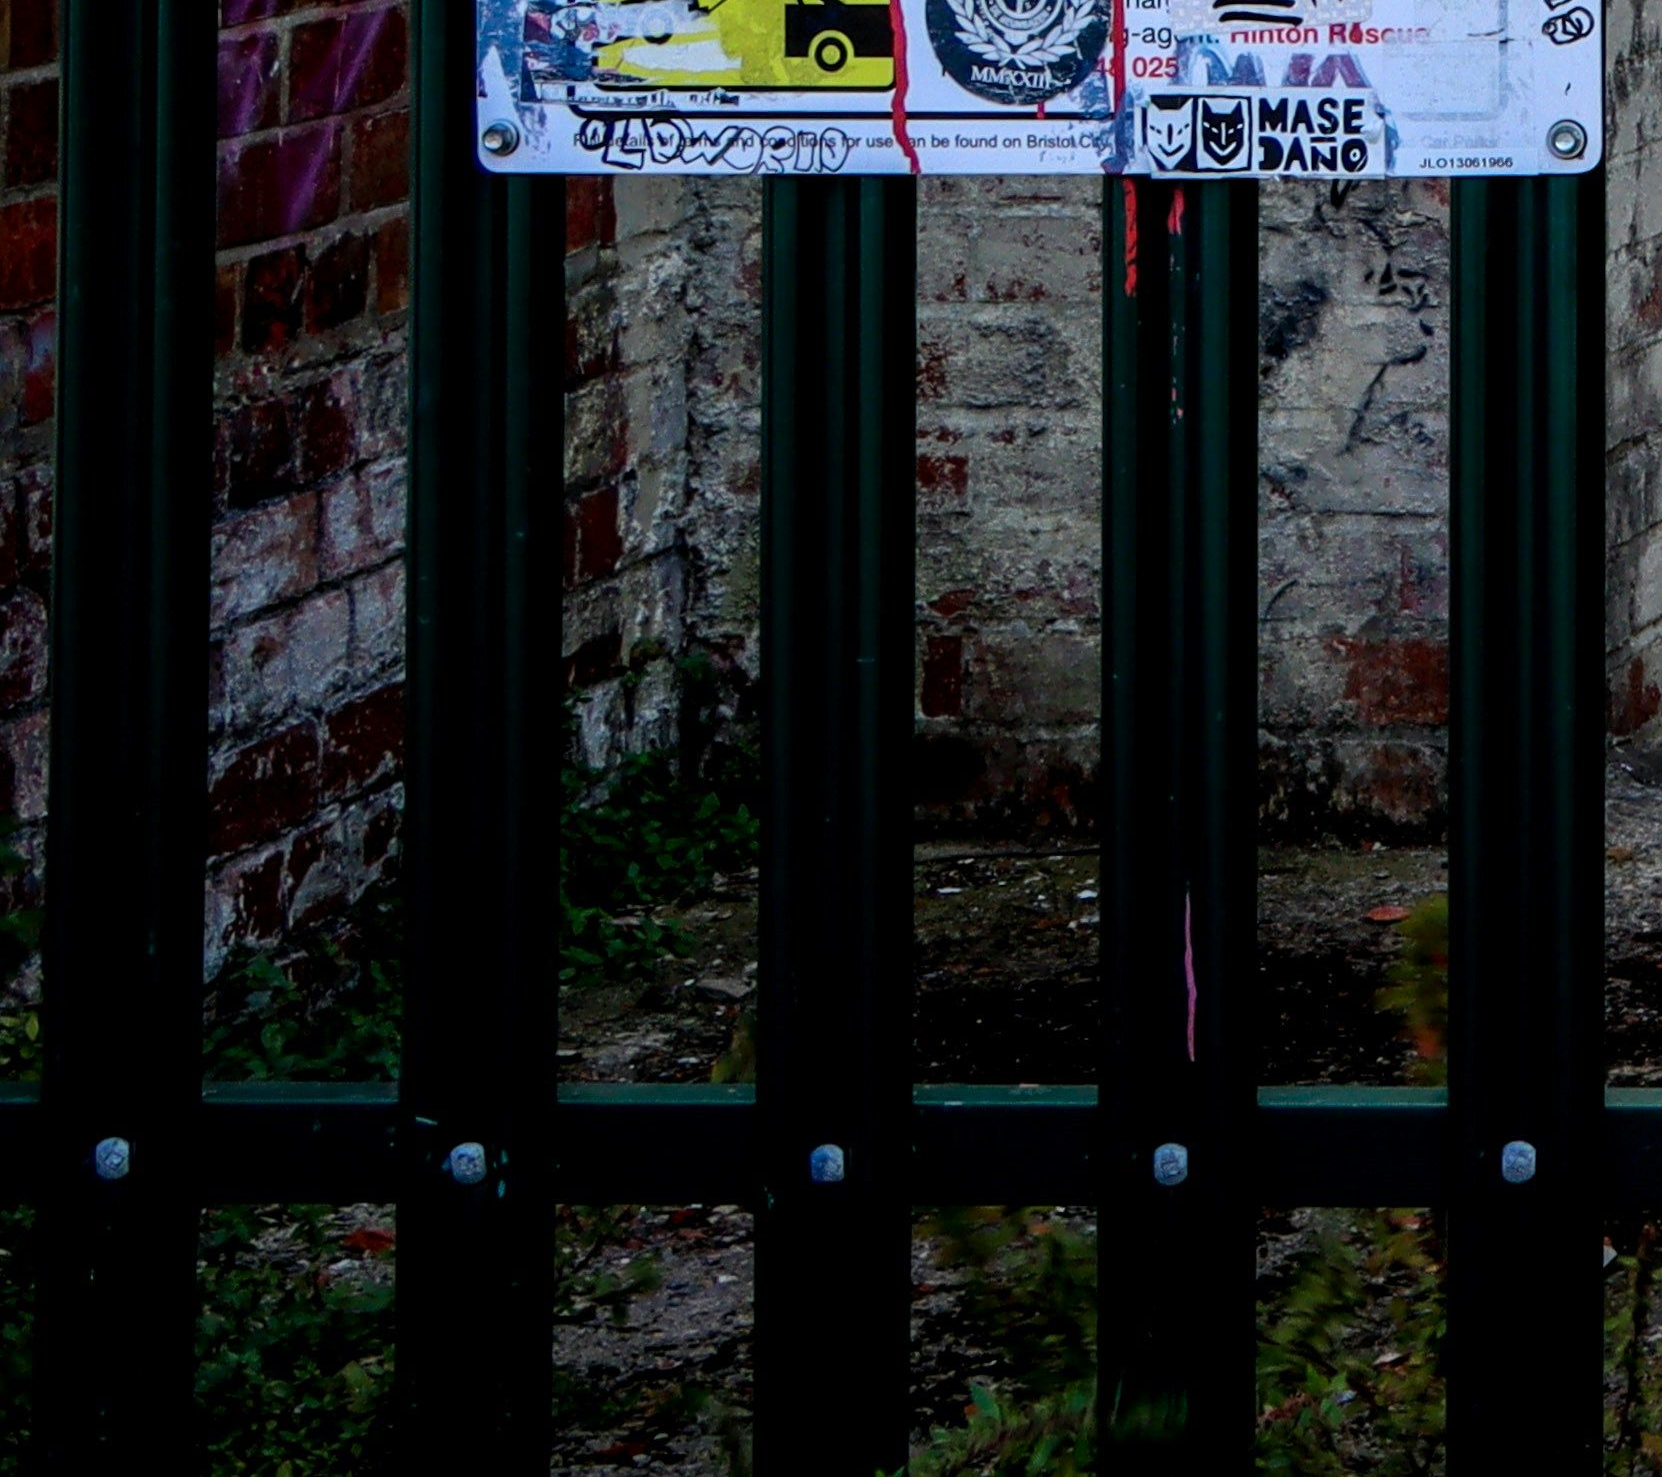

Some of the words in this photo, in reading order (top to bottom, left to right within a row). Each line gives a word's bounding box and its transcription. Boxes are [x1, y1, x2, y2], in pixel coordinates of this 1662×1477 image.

[1258, 98, 1365, 134] MASE
[866, 136, 894, 149] use
[927, 133, 950, 148] be
[955, 133, 998, 148] found
[1002, 135, 1022, 148] on
